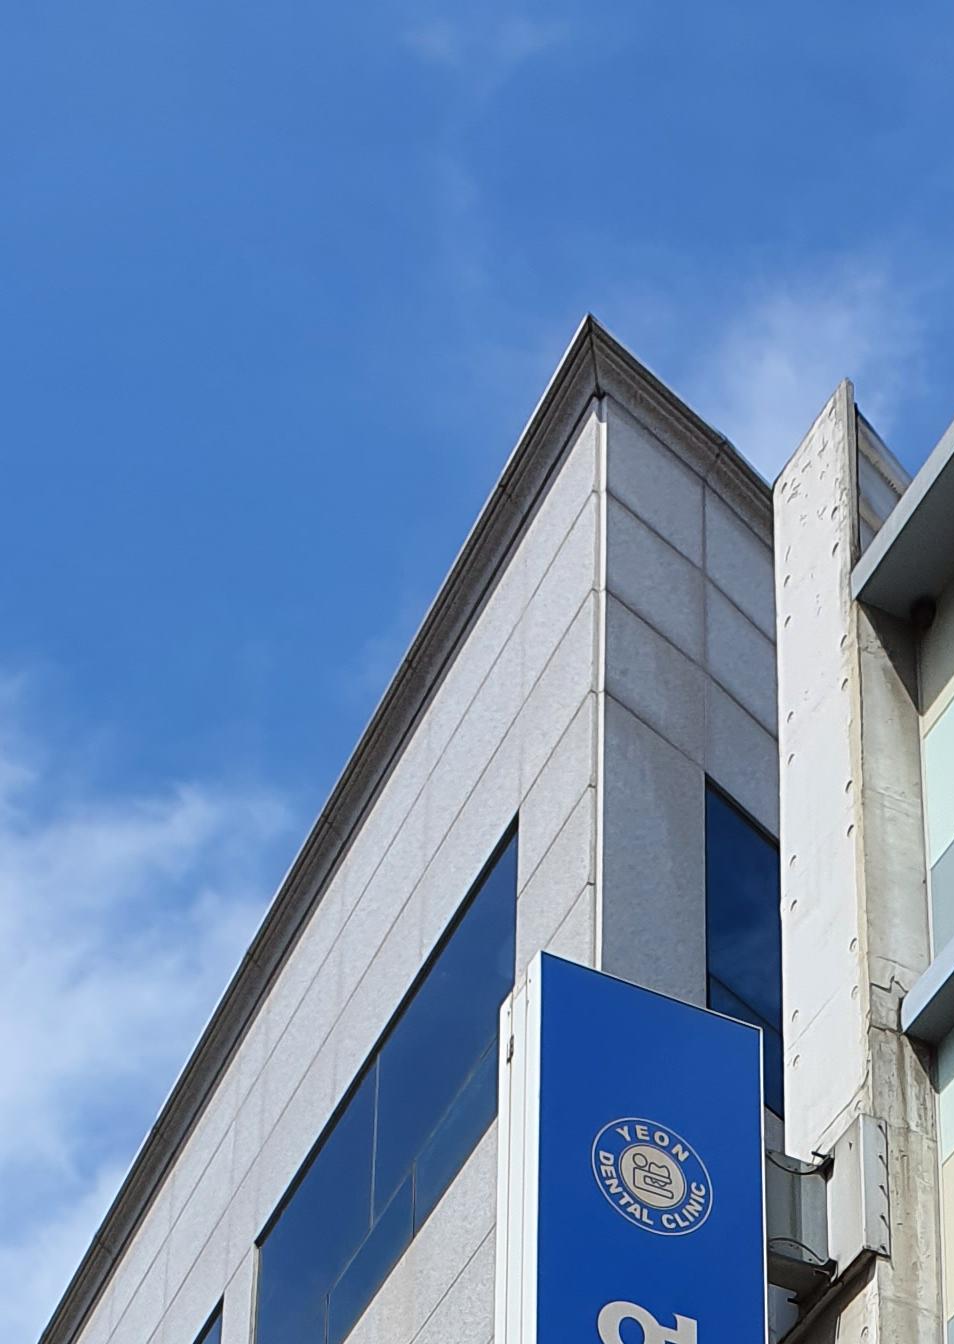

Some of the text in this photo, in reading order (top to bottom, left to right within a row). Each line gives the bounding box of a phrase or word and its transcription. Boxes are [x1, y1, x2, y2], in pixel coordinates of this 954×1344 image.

[616, 1124, 690, 1162] YEON
[599, 1150, 706, 1229] DENTAL CLINIC
